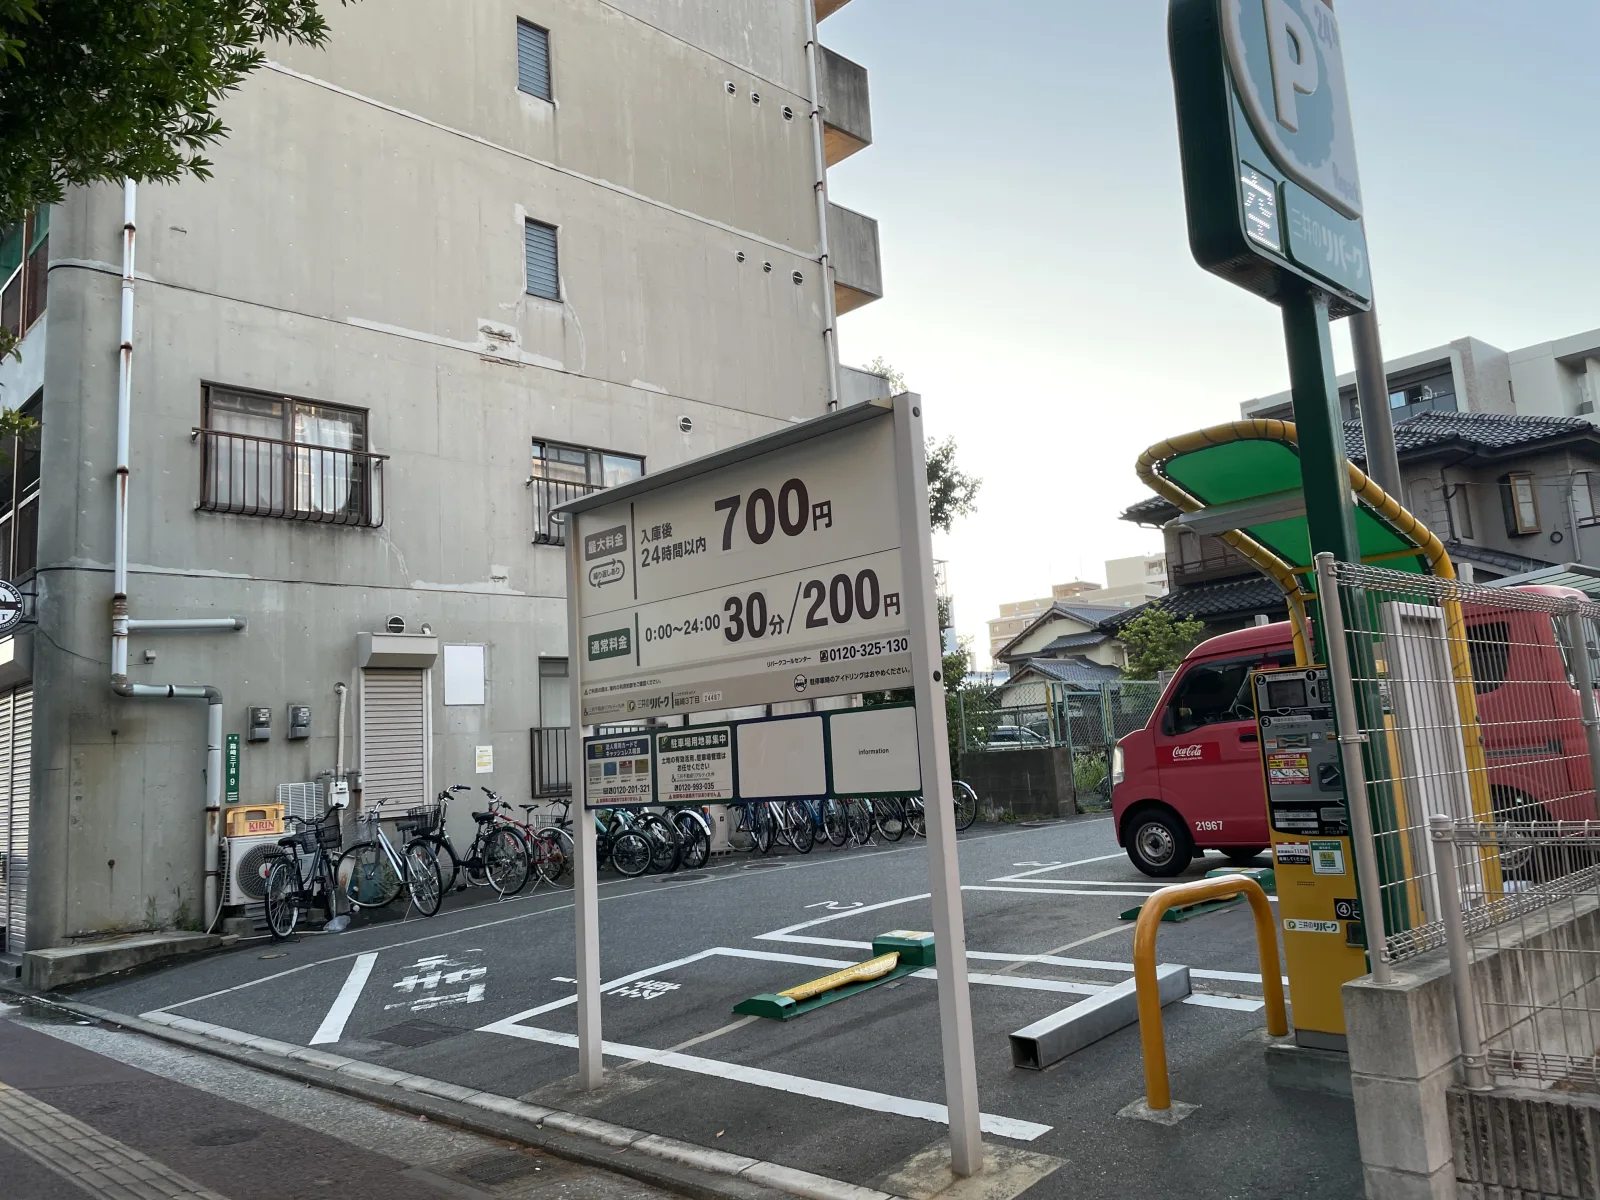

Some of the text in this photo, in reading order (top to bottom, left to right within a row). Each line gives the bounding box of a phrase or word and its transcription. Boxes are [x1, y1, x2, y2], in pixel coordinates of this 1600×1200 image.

[1262, 0, 1320, 134] P
[1291, 207, 1365, 280] 三井のリパーク
[714, 478, 833, 551] 700円
[641, 522, 673, 545] 入庫後
[588, 532, 624, 554] 最大料金
[641, 536, 706, 568] 24時間以内
[593, 567, 620, 580] 繰り返しあり
[591, 635, 628, 655] 通常料金
[766, 637, 909, 668] リパークコールセンター 0120-325-130
[637, 696, 670, 710] 三井のリパーク
[670, 733, 727, 749] 駐車場用地募集中
[676, 763, 710, 772] お任せください
[229, 777, 236, 786] 9
[249, 820, 275, 830] KIRIN
[1195, 820, 1223, 831] 21967
[1298, 921, 1338, 932] 三井のリパーク
